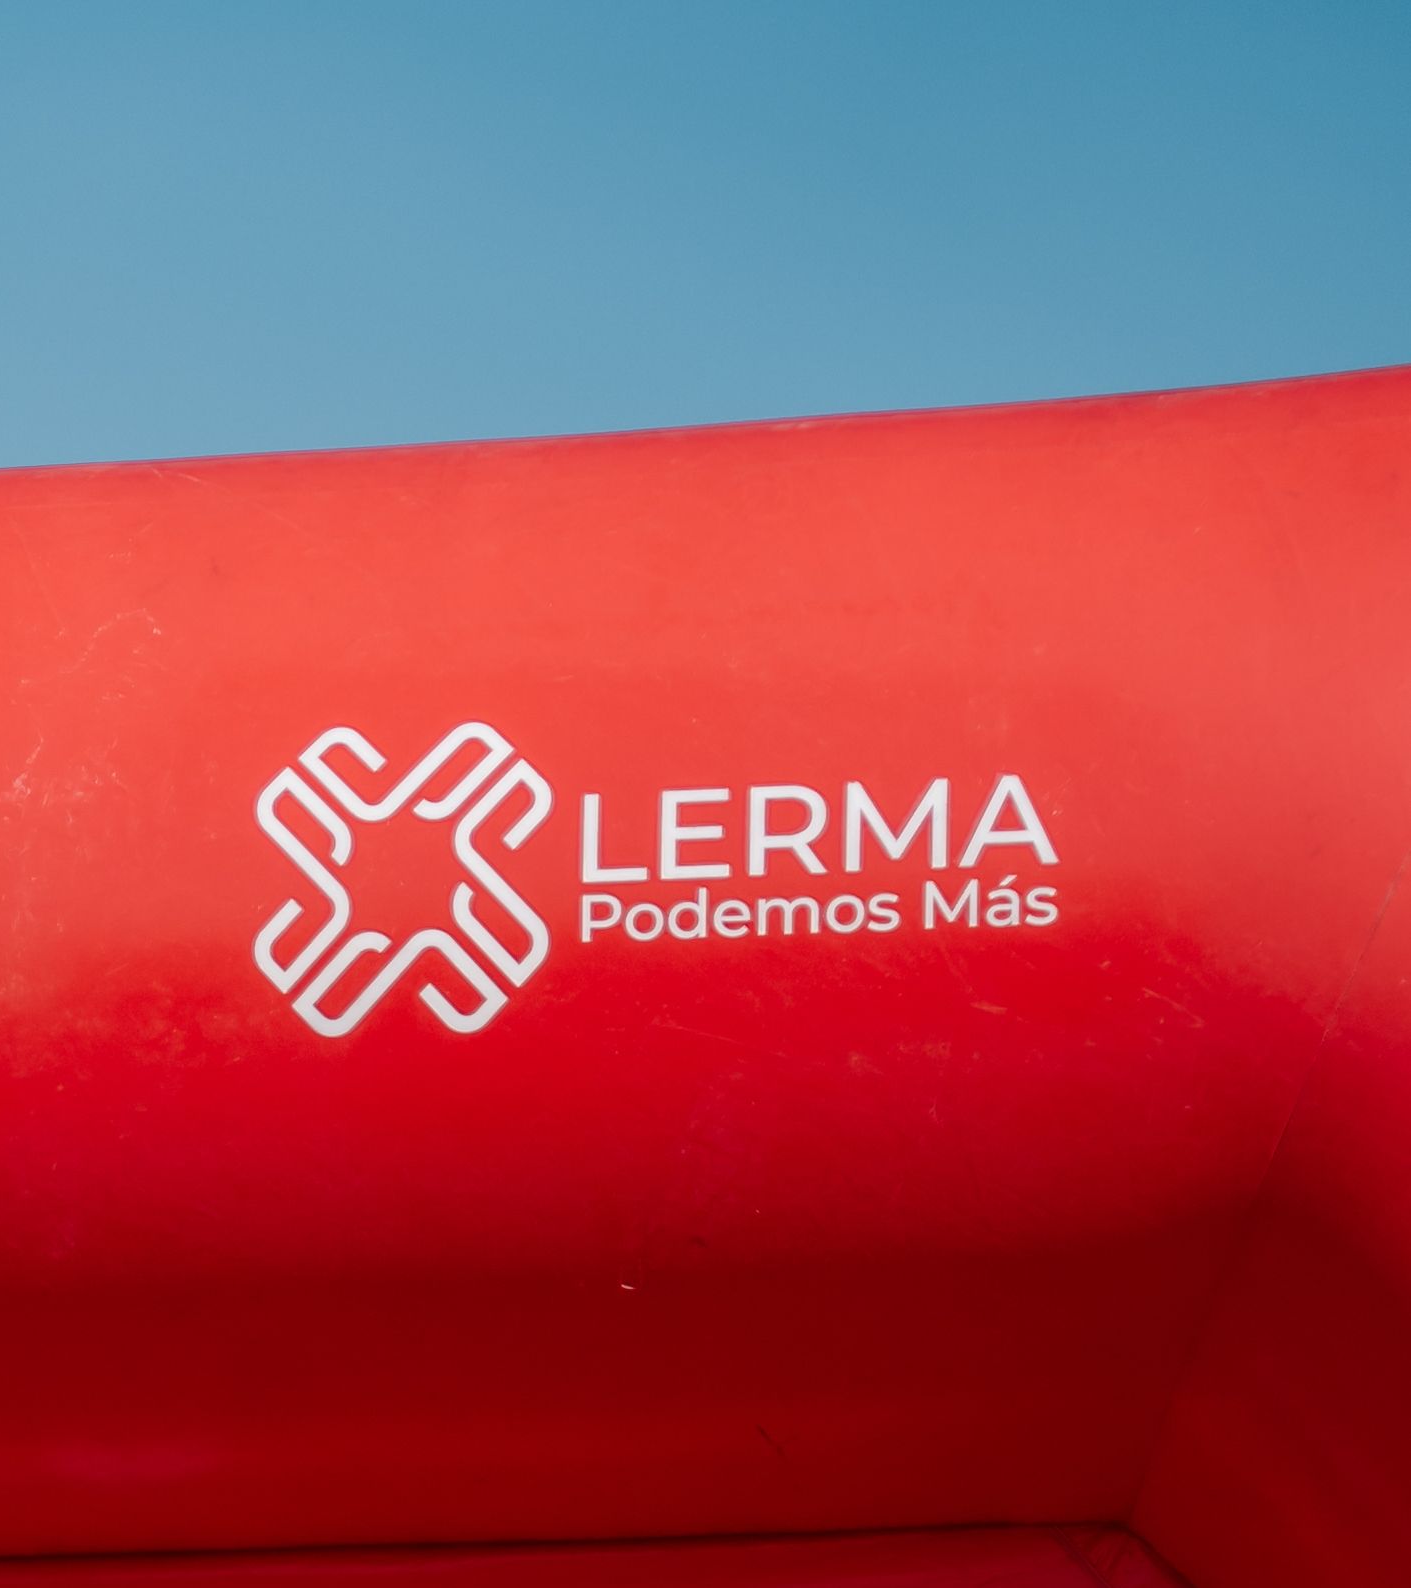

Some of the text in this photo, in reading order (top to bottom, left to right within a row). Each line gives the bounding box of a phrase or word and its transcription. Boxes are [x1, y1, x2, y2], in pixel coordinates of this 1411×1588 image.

[579, 773, 1060, 884] LERMA
[579, 874, 1060, 944] Podemos Más
